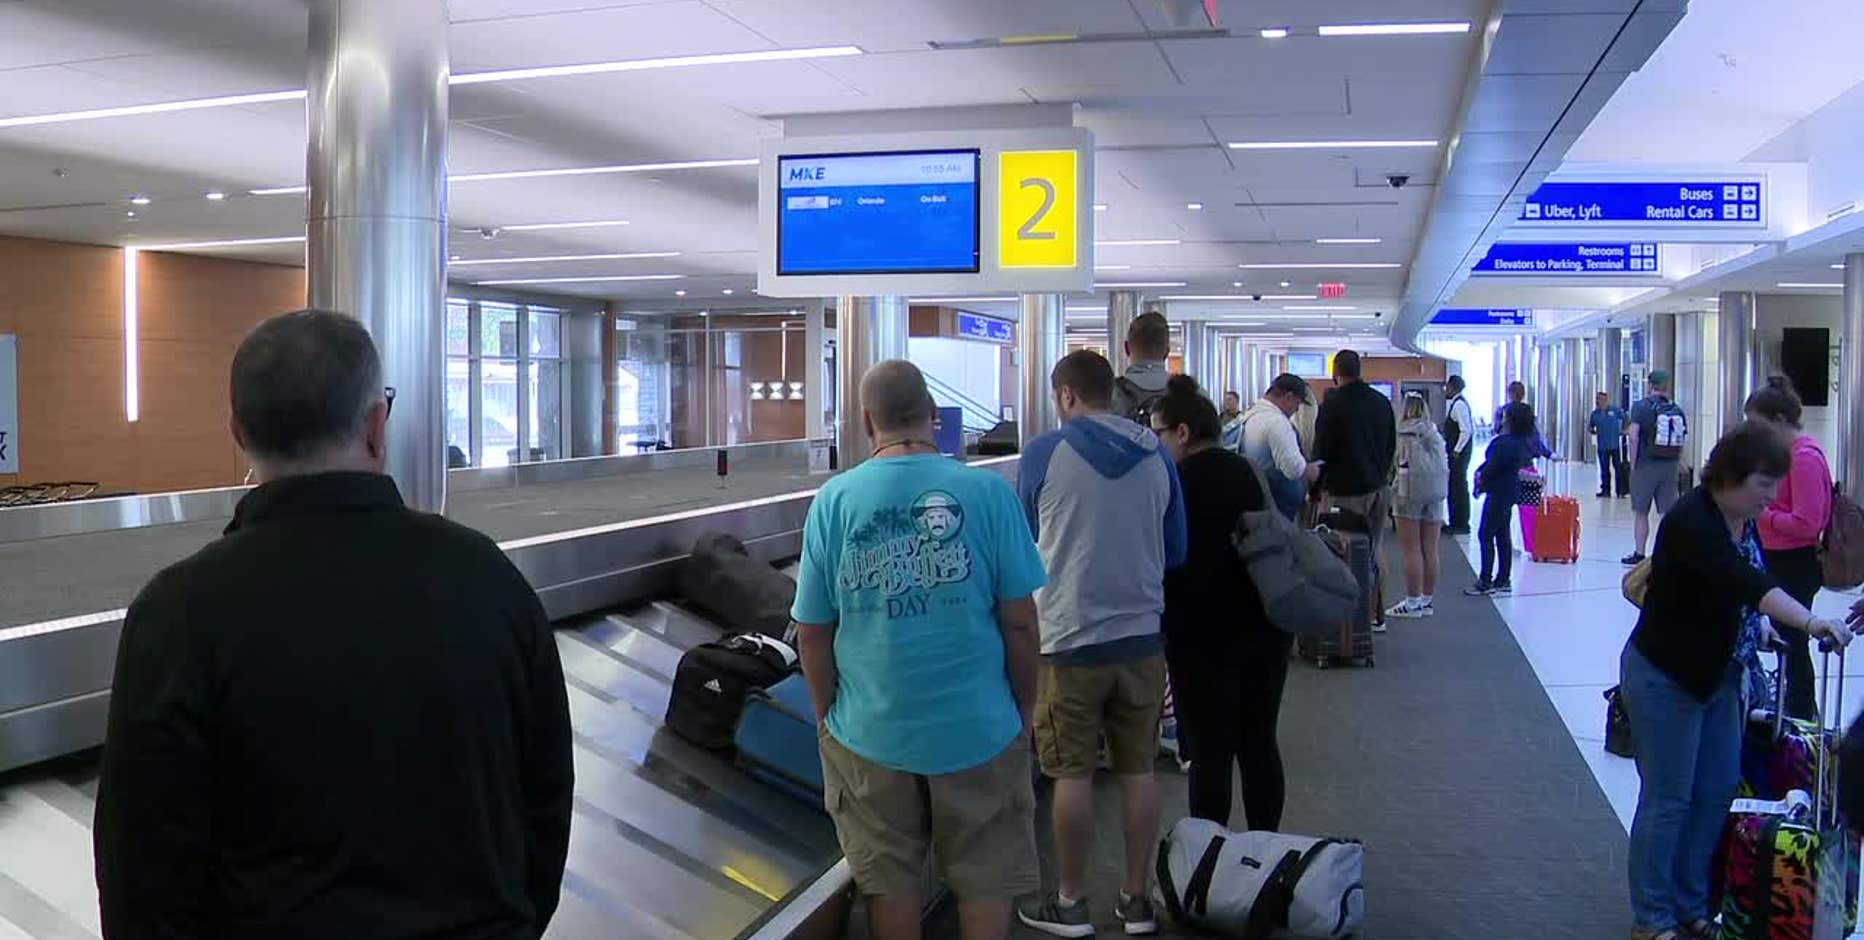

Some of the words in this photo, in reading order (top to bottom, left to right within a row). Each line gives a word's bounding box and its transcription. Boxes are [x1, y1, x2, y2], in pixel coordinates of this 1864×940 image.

[789, 167, 826, 181] MKE
[1680, 187, 1713, 200] Buses
[1016, 177, 1057, 241] 2
[1544, 205, 1576, 219] Uber,
[1579, 204, 1602, 220] Lyft
[1646, 205, 1685, 219] Rental
[1687, 206, 1713, 219] Cars
[1578, 246, 1625, 257] Restrooms
[1494, 259, 1534, 269] Elevators
[1536, 260, 1546, 269] to
[1548, 259, 1584, 272] Parking,
[1586, 259, 1625, 269] Terminal
[838, 533, 930, 593] Jimmy
[861, 539, 973, 597] Buffett
[887, 595, 931, 620] DAY
